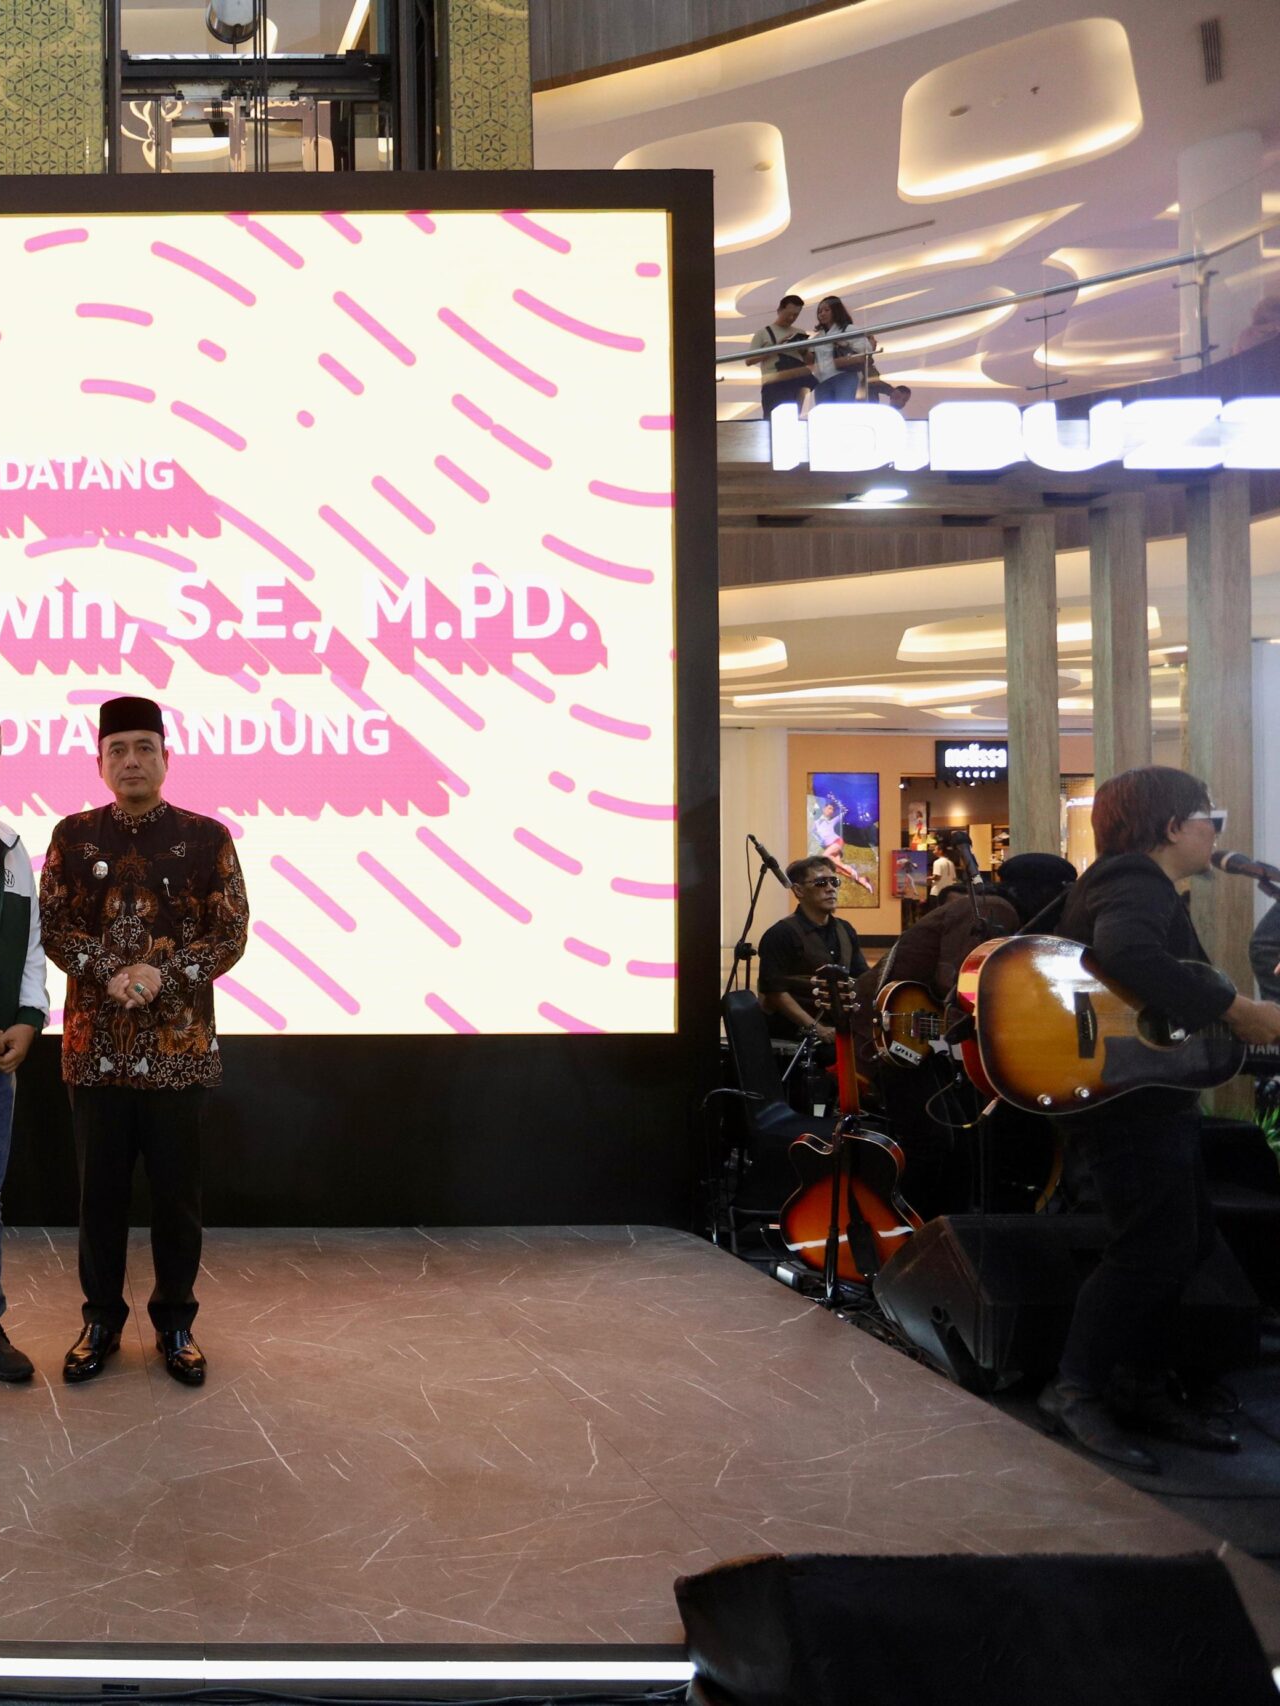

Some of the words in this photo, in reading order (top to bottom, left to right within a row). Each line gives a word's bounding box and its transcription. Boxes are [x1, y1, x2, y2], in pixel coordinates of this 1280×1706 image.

[165, 571, 336, 653] S.E.,
[362, 572, 588, 640] M.PD.
[0, 708, 97, 755] OTA
[162, 708, 389, 755] ANDUNG
